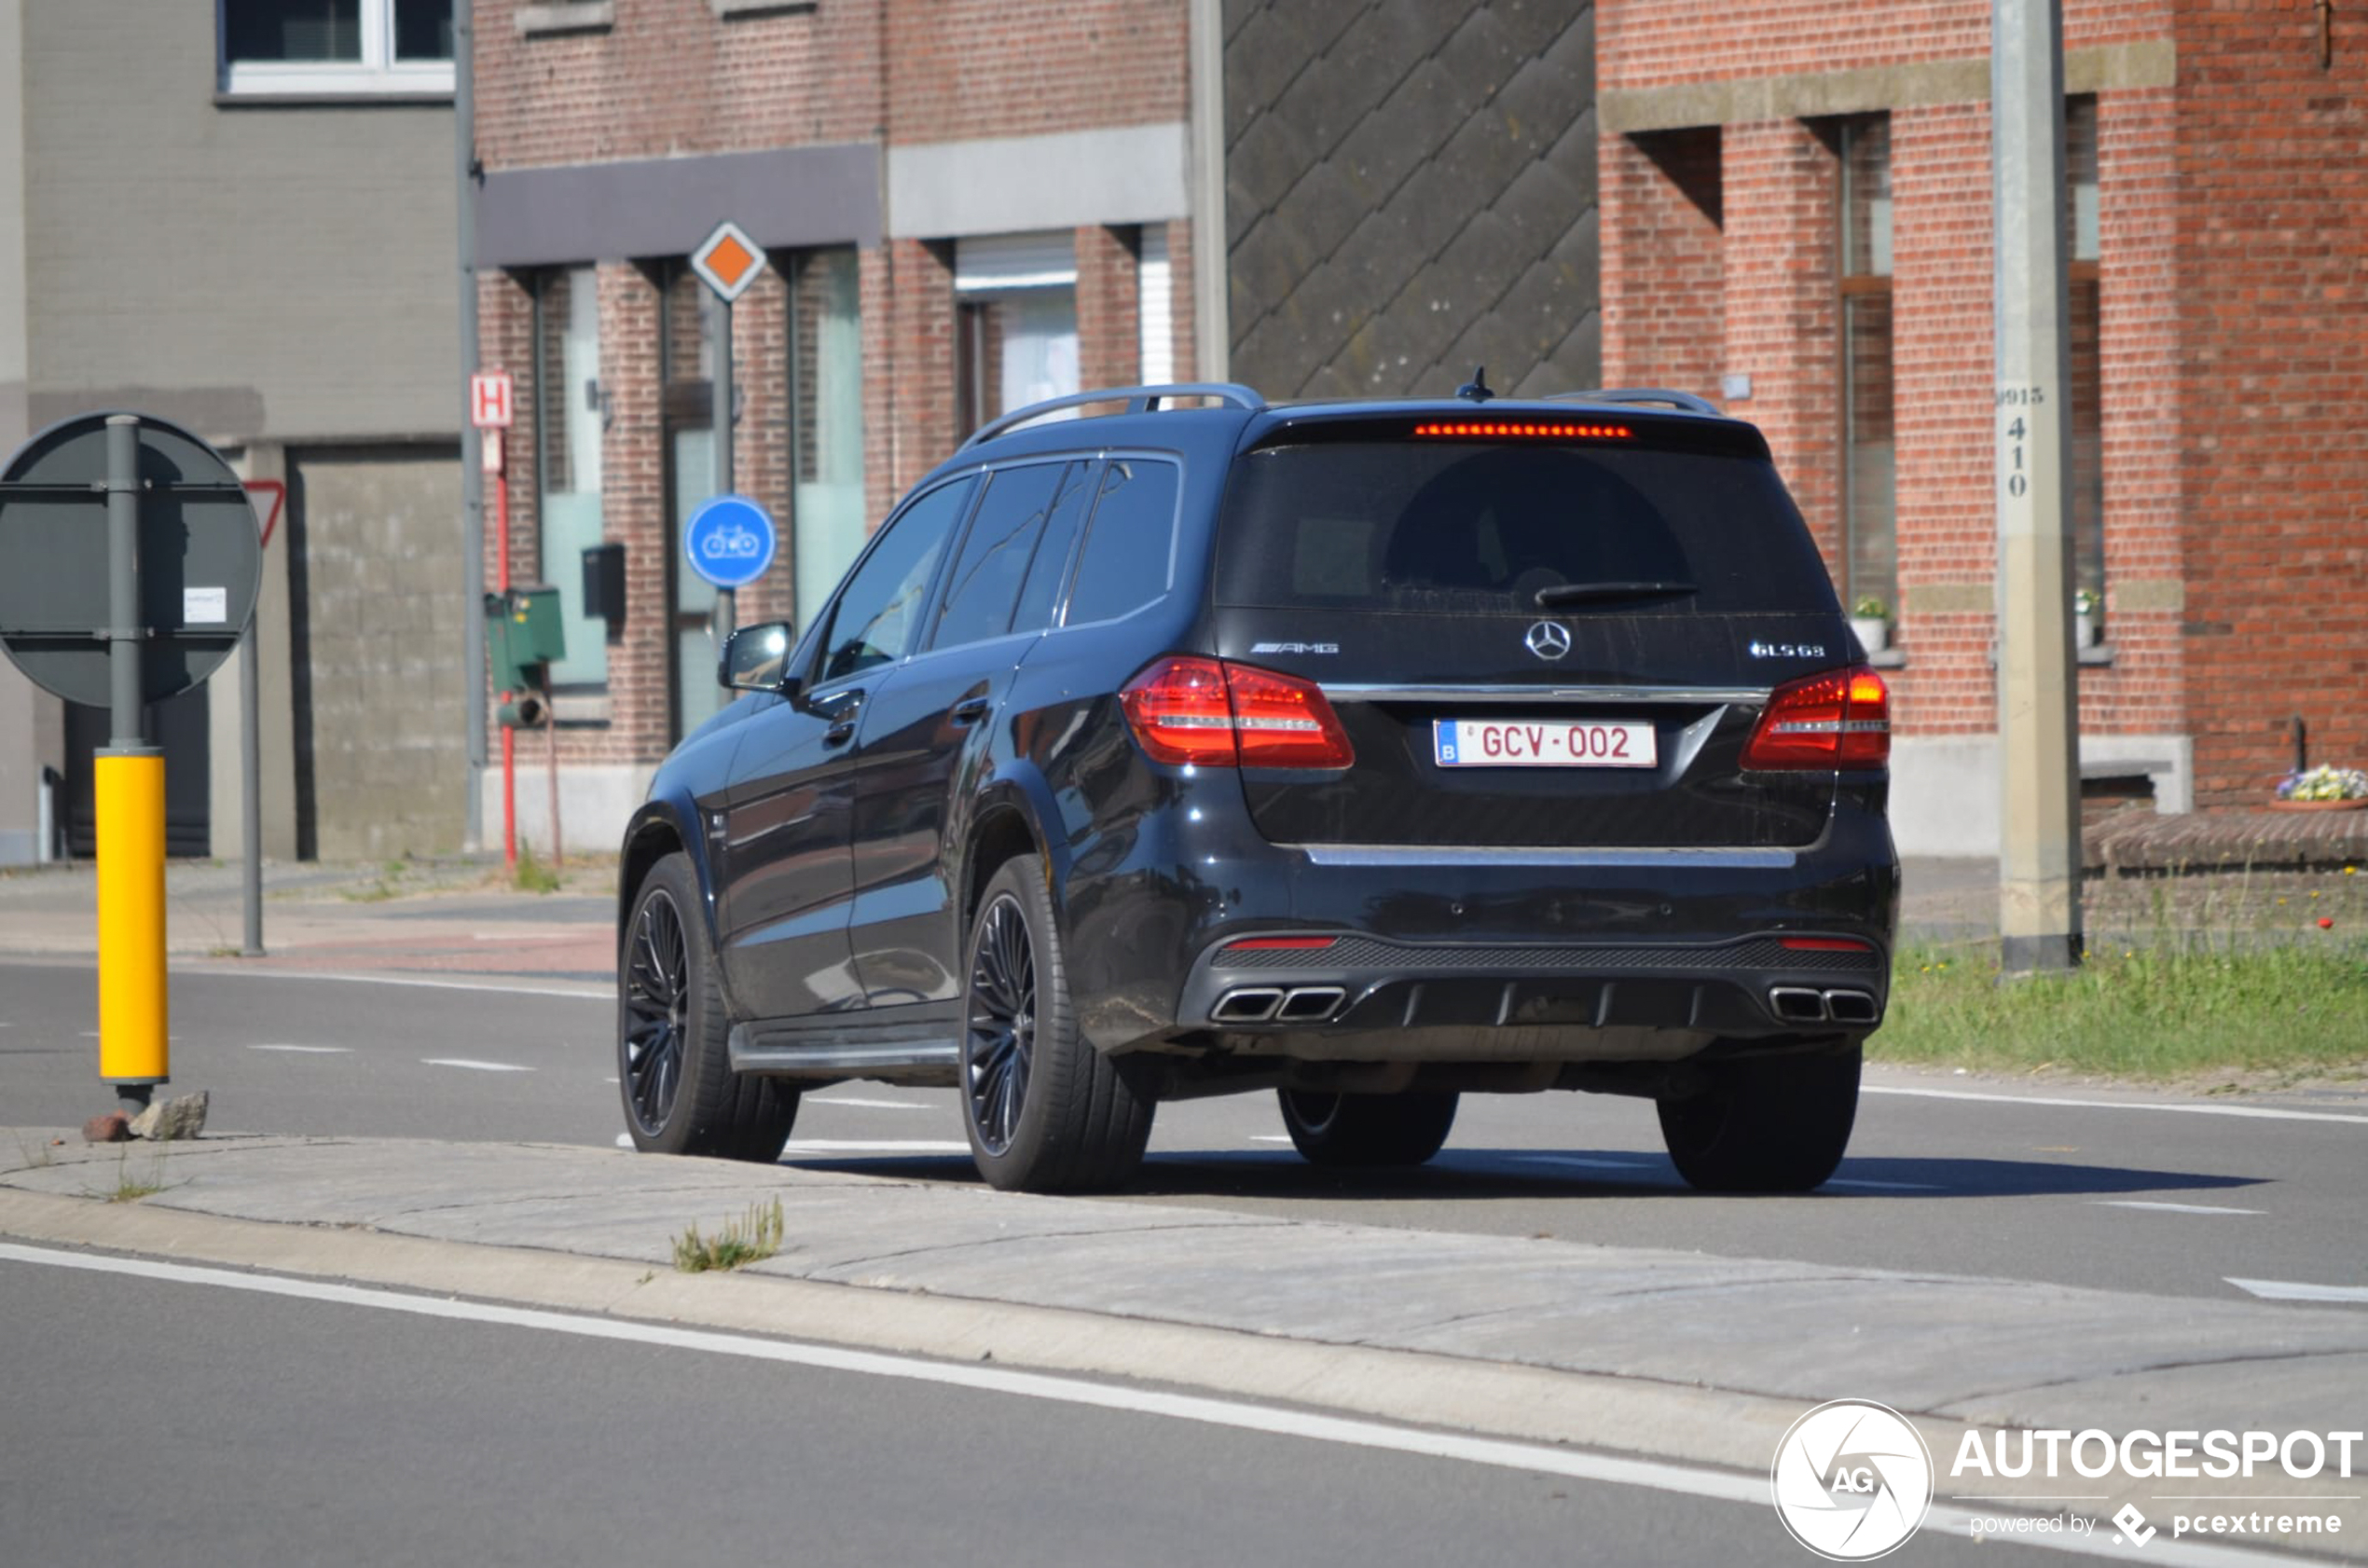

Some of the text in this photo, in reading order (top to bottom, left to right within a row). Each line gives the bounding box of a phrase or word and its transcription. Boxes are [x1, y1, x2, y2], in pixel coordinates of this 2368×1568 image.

[479, 381, 504, 418] H
[1278, 643, 1340, 653] AMG
[1442, 745, 1455, 760] B
[1482, 726, 1630, 757] GCV-002
